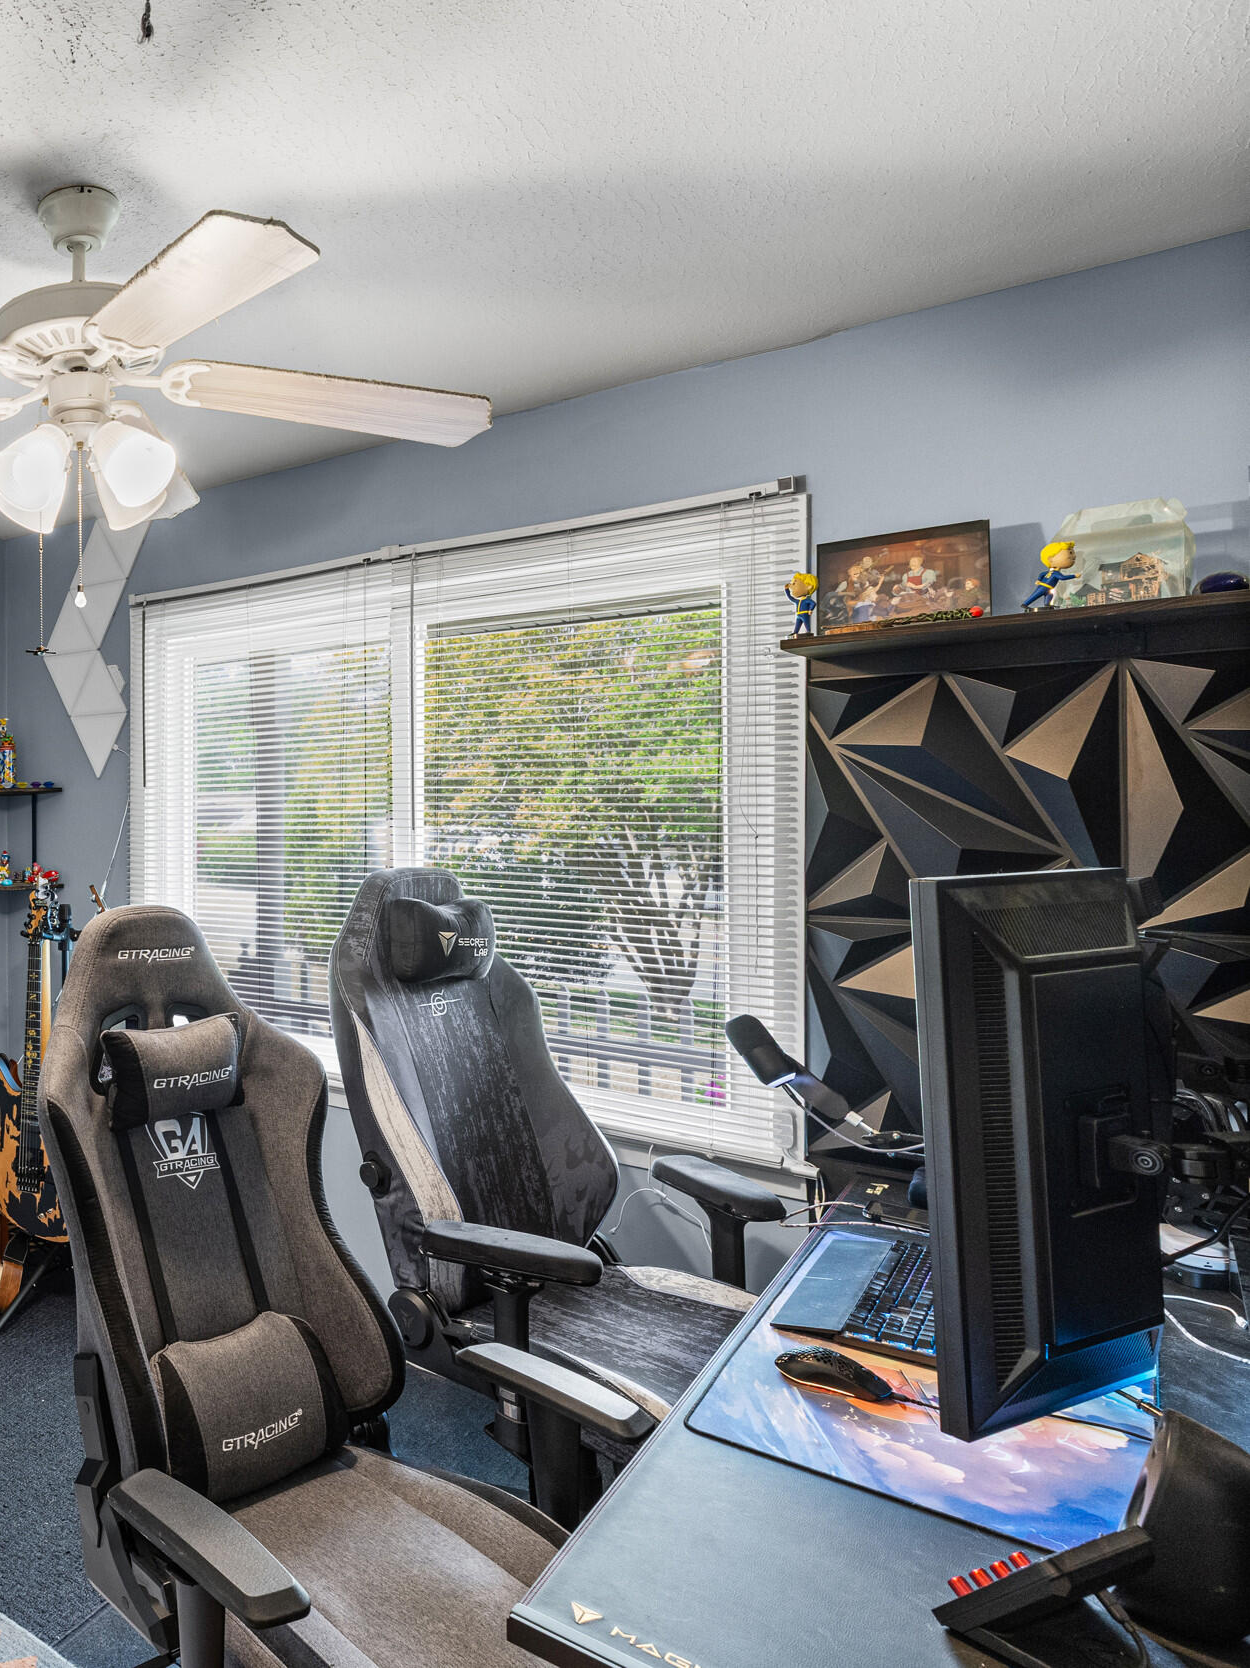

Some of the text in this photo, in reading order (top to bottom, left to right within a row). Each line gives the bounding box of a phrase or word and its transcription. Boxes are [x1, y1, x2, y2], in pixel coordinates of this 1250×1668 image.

[458, 938, 488, 947] SECRET
[118, 947, 192, 963] GTRACING
[474, 948, 488, 957] LAB
[153, 1067, 231, 1090] GTRACING
[160, 1156, 214, 1172] GTRACING
[222, 1412, 299, 1452] GTRACING
